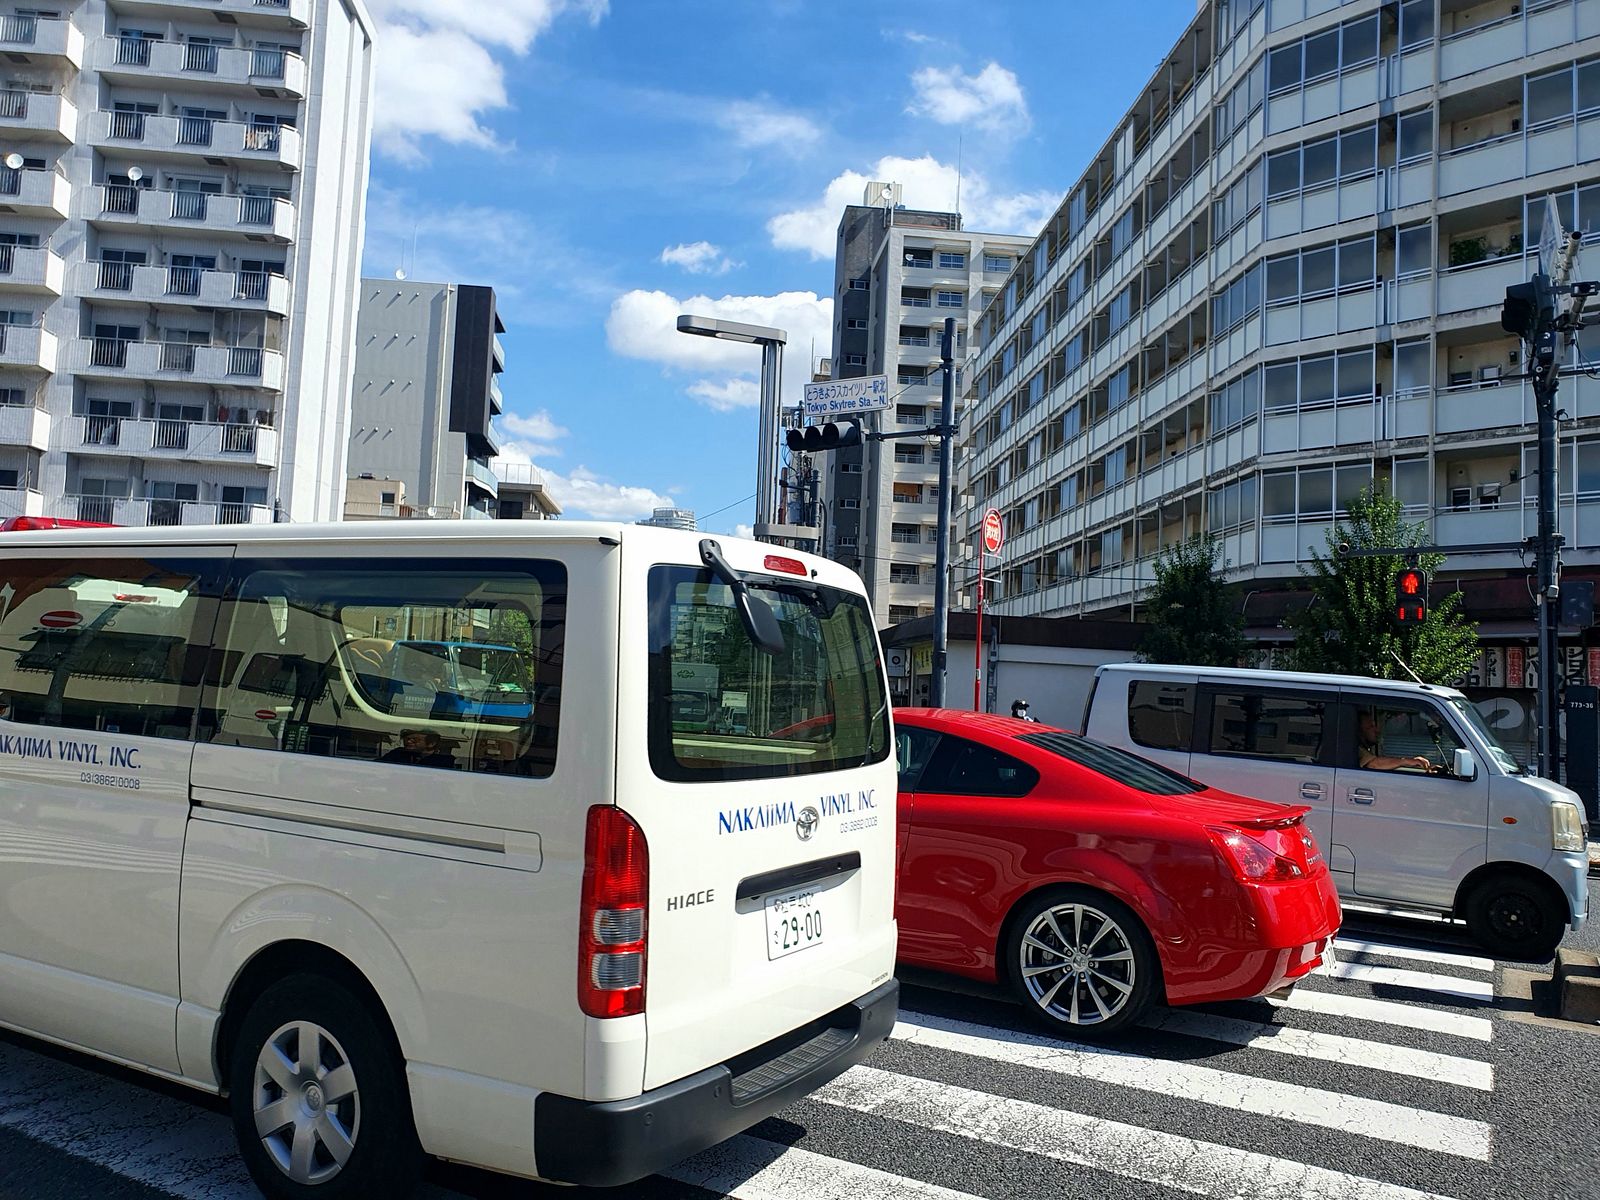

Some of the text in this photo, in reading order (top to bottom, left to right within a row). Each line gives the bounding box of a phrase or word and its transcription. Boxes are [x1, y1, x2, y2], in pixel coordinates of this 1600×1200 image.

[807, 402, 828, 413] Tokyo
[829, 398, 857, 411] Skytree
[58, 740, 103, 766] VINYL,
[109, 746, 142, 769] INC.
[667, 888, 715, 911] HIACE
